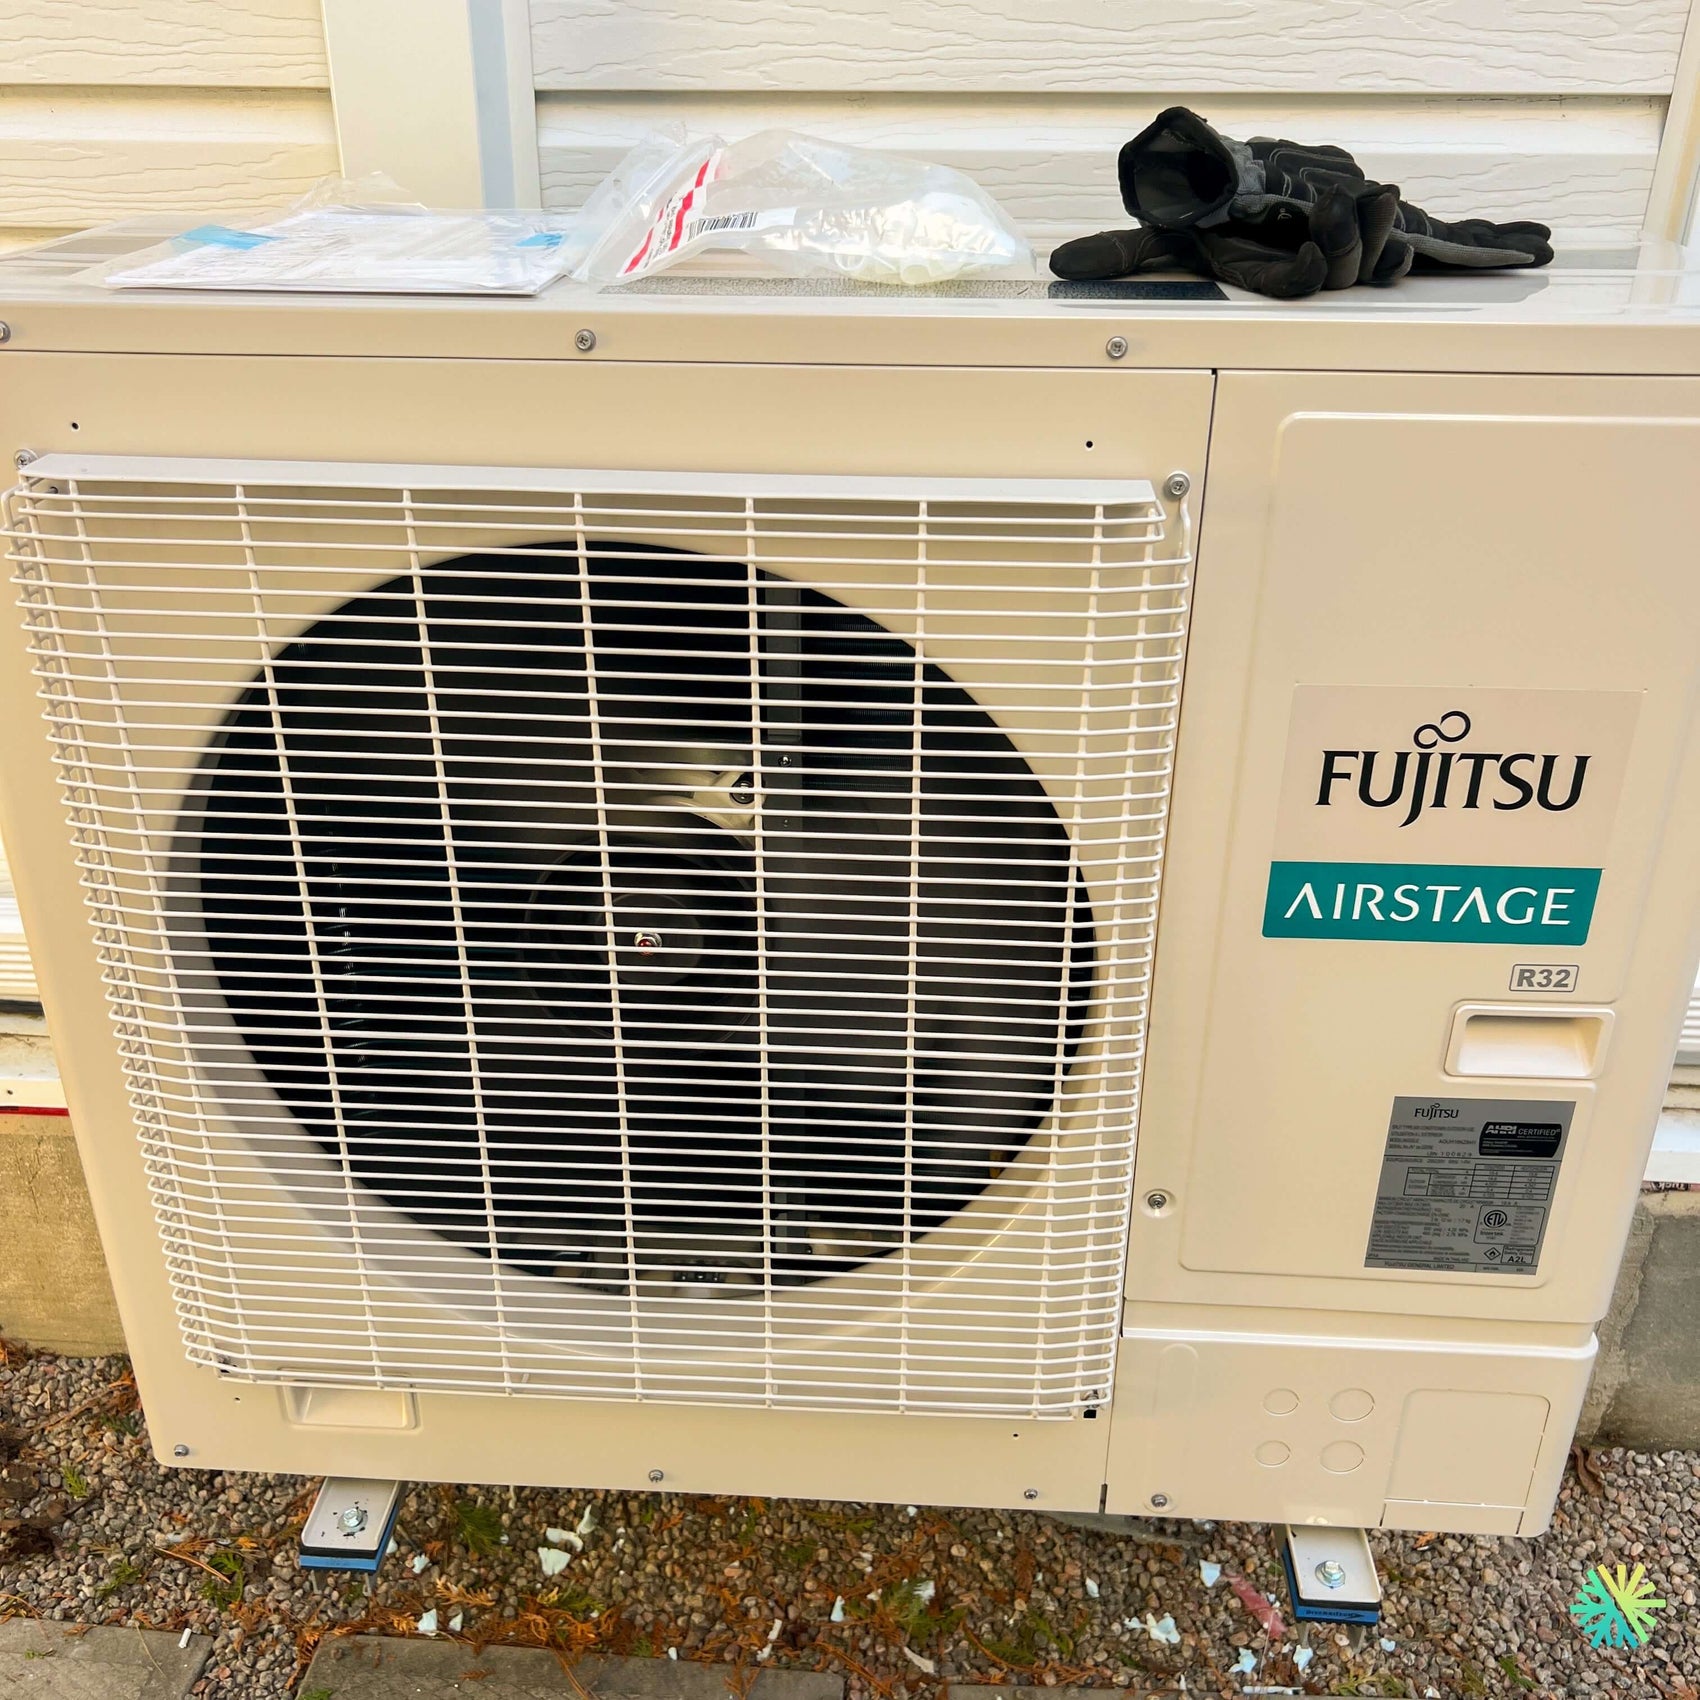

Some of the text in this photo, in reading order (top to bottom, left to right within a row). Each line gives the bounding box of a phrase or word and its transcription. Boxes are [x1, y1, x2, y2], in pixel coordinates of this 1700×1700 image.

[1315, 711, 1592, 828] FUJITSU
[1284, 882, 1577, 926] AIRSTAGE
[1516, 968, 1571, 988] R32
[1414, 1103, 1459, 1121] FUJITSU
[1485, 1124, 1517, 1135] AHRI
[1486, 1212, 1505, 1227] ETL
[1508, 1255, 1526, 1263] A2L
